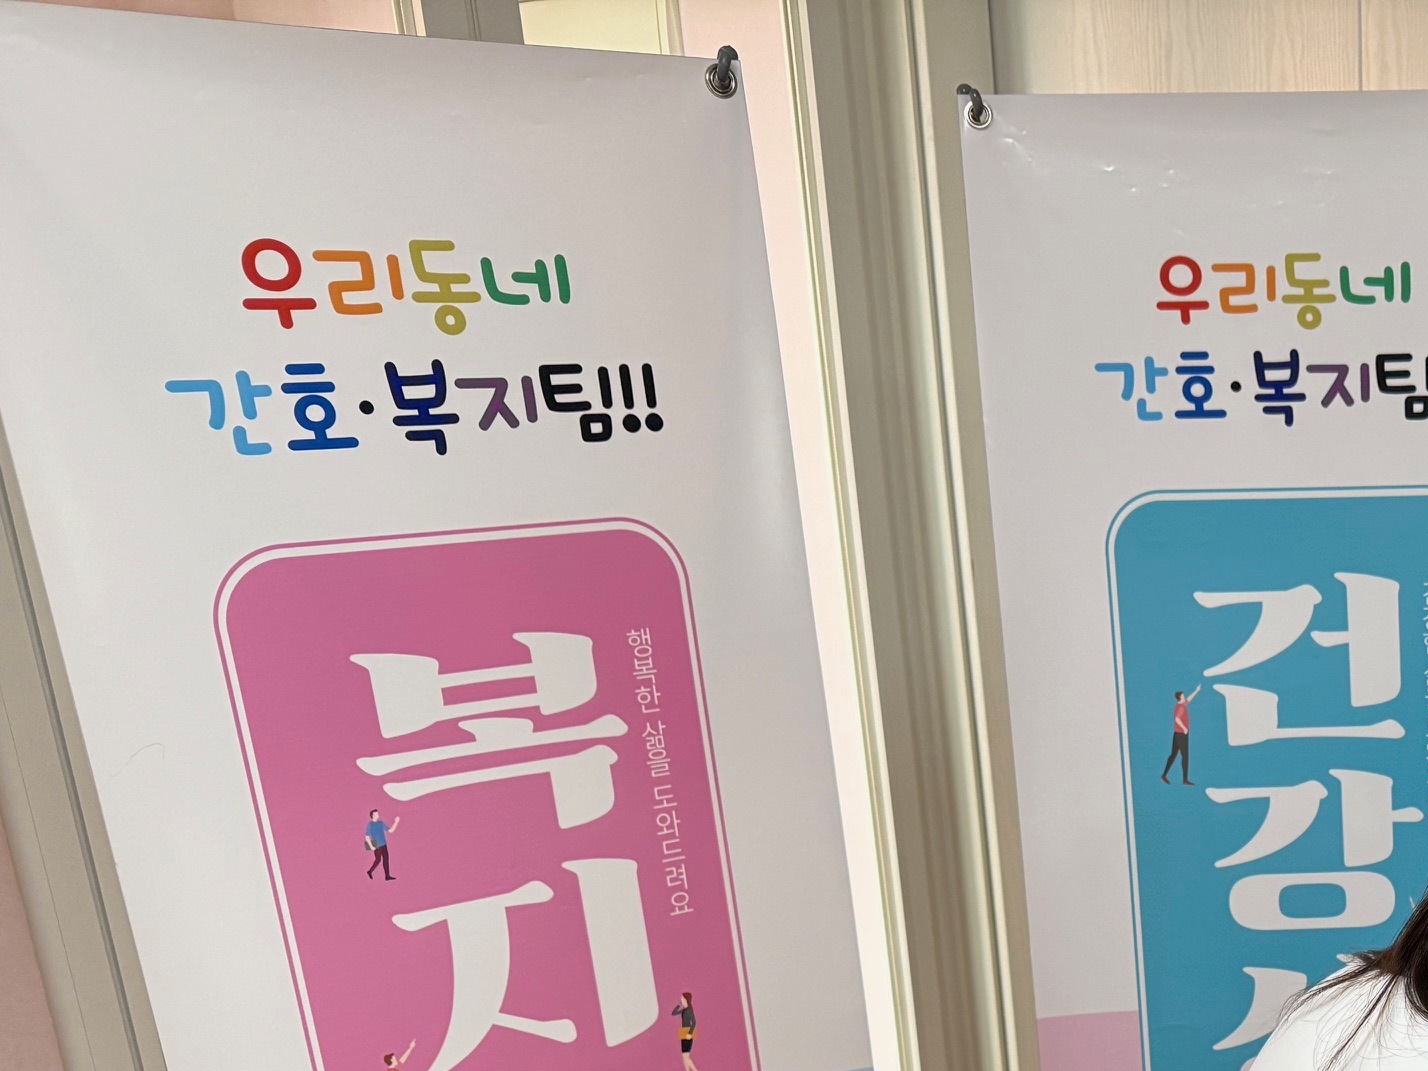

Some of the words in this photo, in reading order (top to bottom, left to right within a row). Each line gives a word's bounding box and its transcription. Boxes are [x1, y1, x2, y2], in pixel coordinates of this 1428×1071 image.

[241, 237, 572, 336] 우리동네
[1156, 252, 1412, 330] 우리동네
[164, 358, 664, 456] 간호·복지팀!!
[626, 627, 661, 714] 행복한
[642, 721, 671, 776] 삶을
[653, 785, 694, 916] 도와드려요
